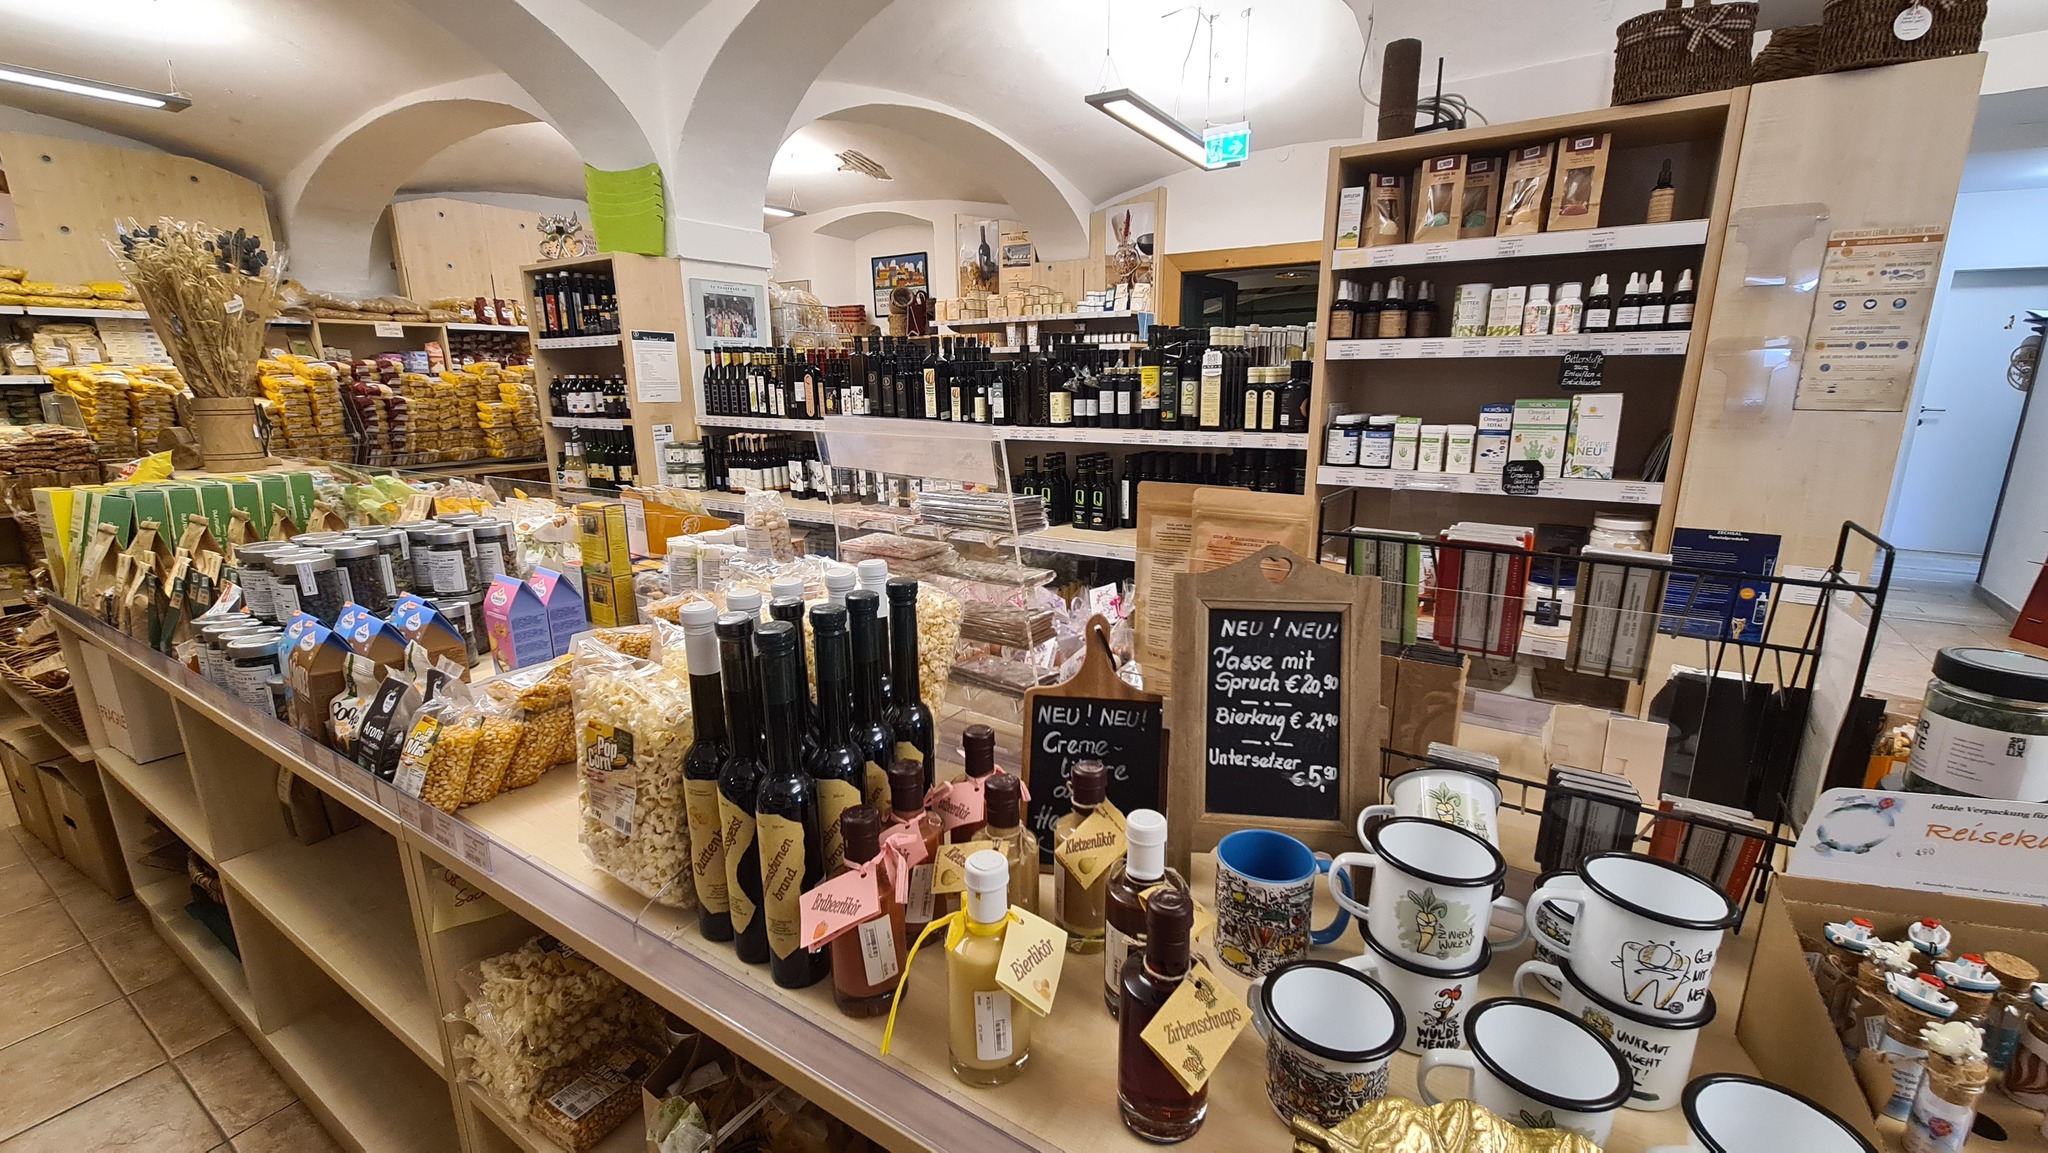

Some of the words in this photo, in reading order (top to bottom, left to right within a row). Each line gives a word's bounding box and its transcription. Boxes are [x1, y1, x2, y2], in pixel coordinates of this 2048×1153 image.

[1182, 383, 1194, 406] bio
[1075, 489, 1085, 506] Q
[1093, 491, 1103, 507] Q
[1213, 646, 1273, 671] Tasse
[1281, 650, 1316, 670] mit
[1215, 671, 1280, 698] Spruch
[1216, 707, 1286, 741] Bierkrug
[588, 747, 612, 771] Corn
[597, 736, 618, 762] Pop
[1209, 747, 1302, 770] Untersetzer
[1931, 803, 1964, 812] Ideale
[1967, 806, 2030, 819] Verpackung
[2032, 811, 2048, 820] für
[1065, 831, 1117, 855] Kletzenlikör
[1925, 822, 2048, 849] Reisek
[772, 867, 798, 902] brand
[811, 893, 862, 917] Erdbeerlikör
[1010, 939, 1055, 982] Eierlikör
[1163, 1006, 1242, 1045] Zirbenschnaps
[1417, 1025, 1460, 1040] WÜLDE
[1616, 1029, 1671, 1056] UNKRAUT
